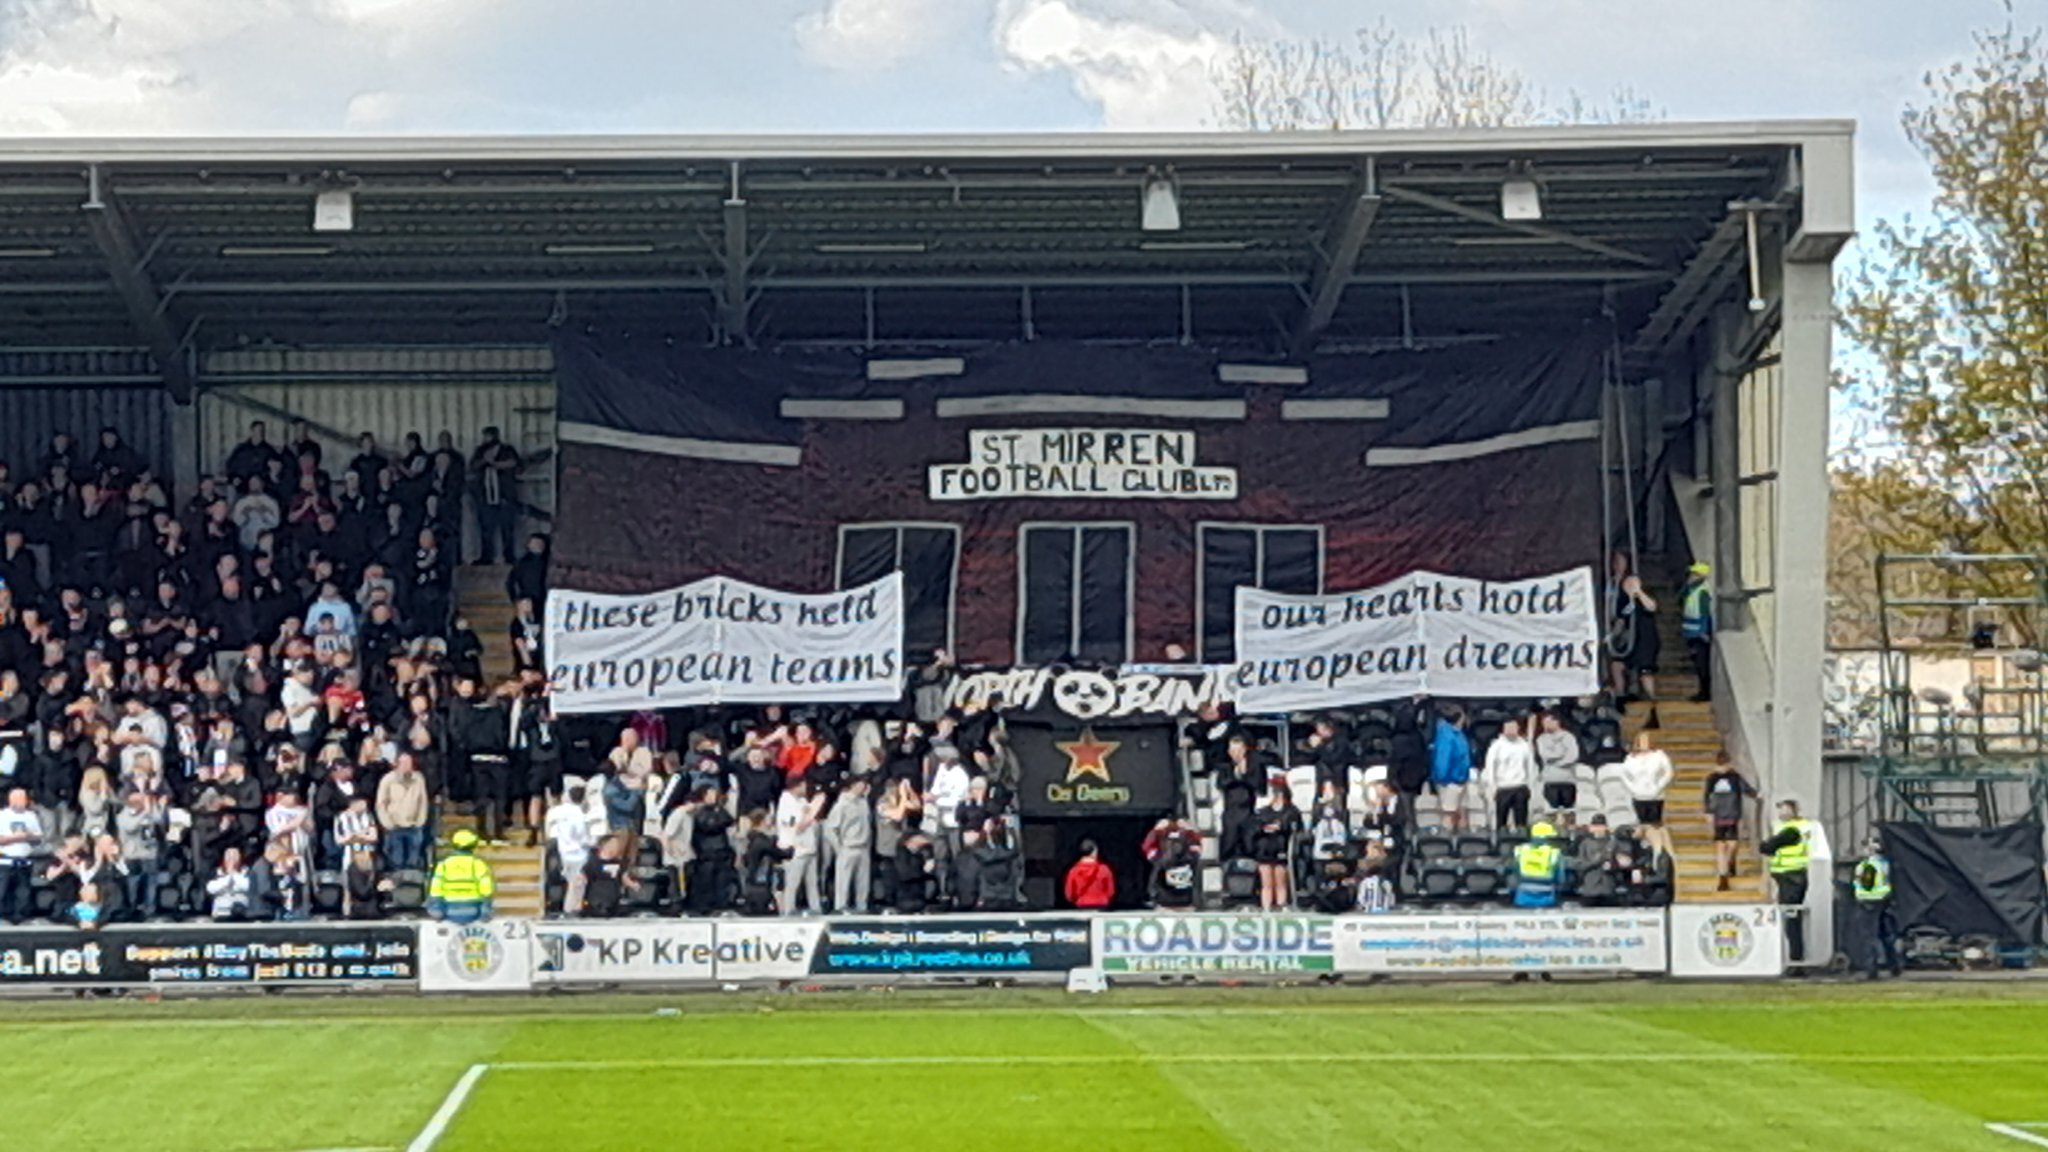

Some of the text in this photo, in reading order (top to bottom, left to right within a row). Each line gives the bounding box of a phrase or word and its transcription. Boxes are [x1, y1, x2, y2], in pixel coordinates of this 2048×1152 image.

[981, 431, 1184, 464] ST MIRREN
[940, 464, 1108, 495] FOOTBALL
[1121, 467, 1198, 493] CLUB
[563, 584, 879, 632] these bricks held
[1261, 579, 1567, 630] our hearts hold
[551, 647, 897, 697] european teams
[1236, 635, 1596, 689] european dreams
[1753, 907, 1778, 927] 24
[599, 936, 805, 965] KP Kreative
[1103, 918, 1335, 953] ROADSIDE
